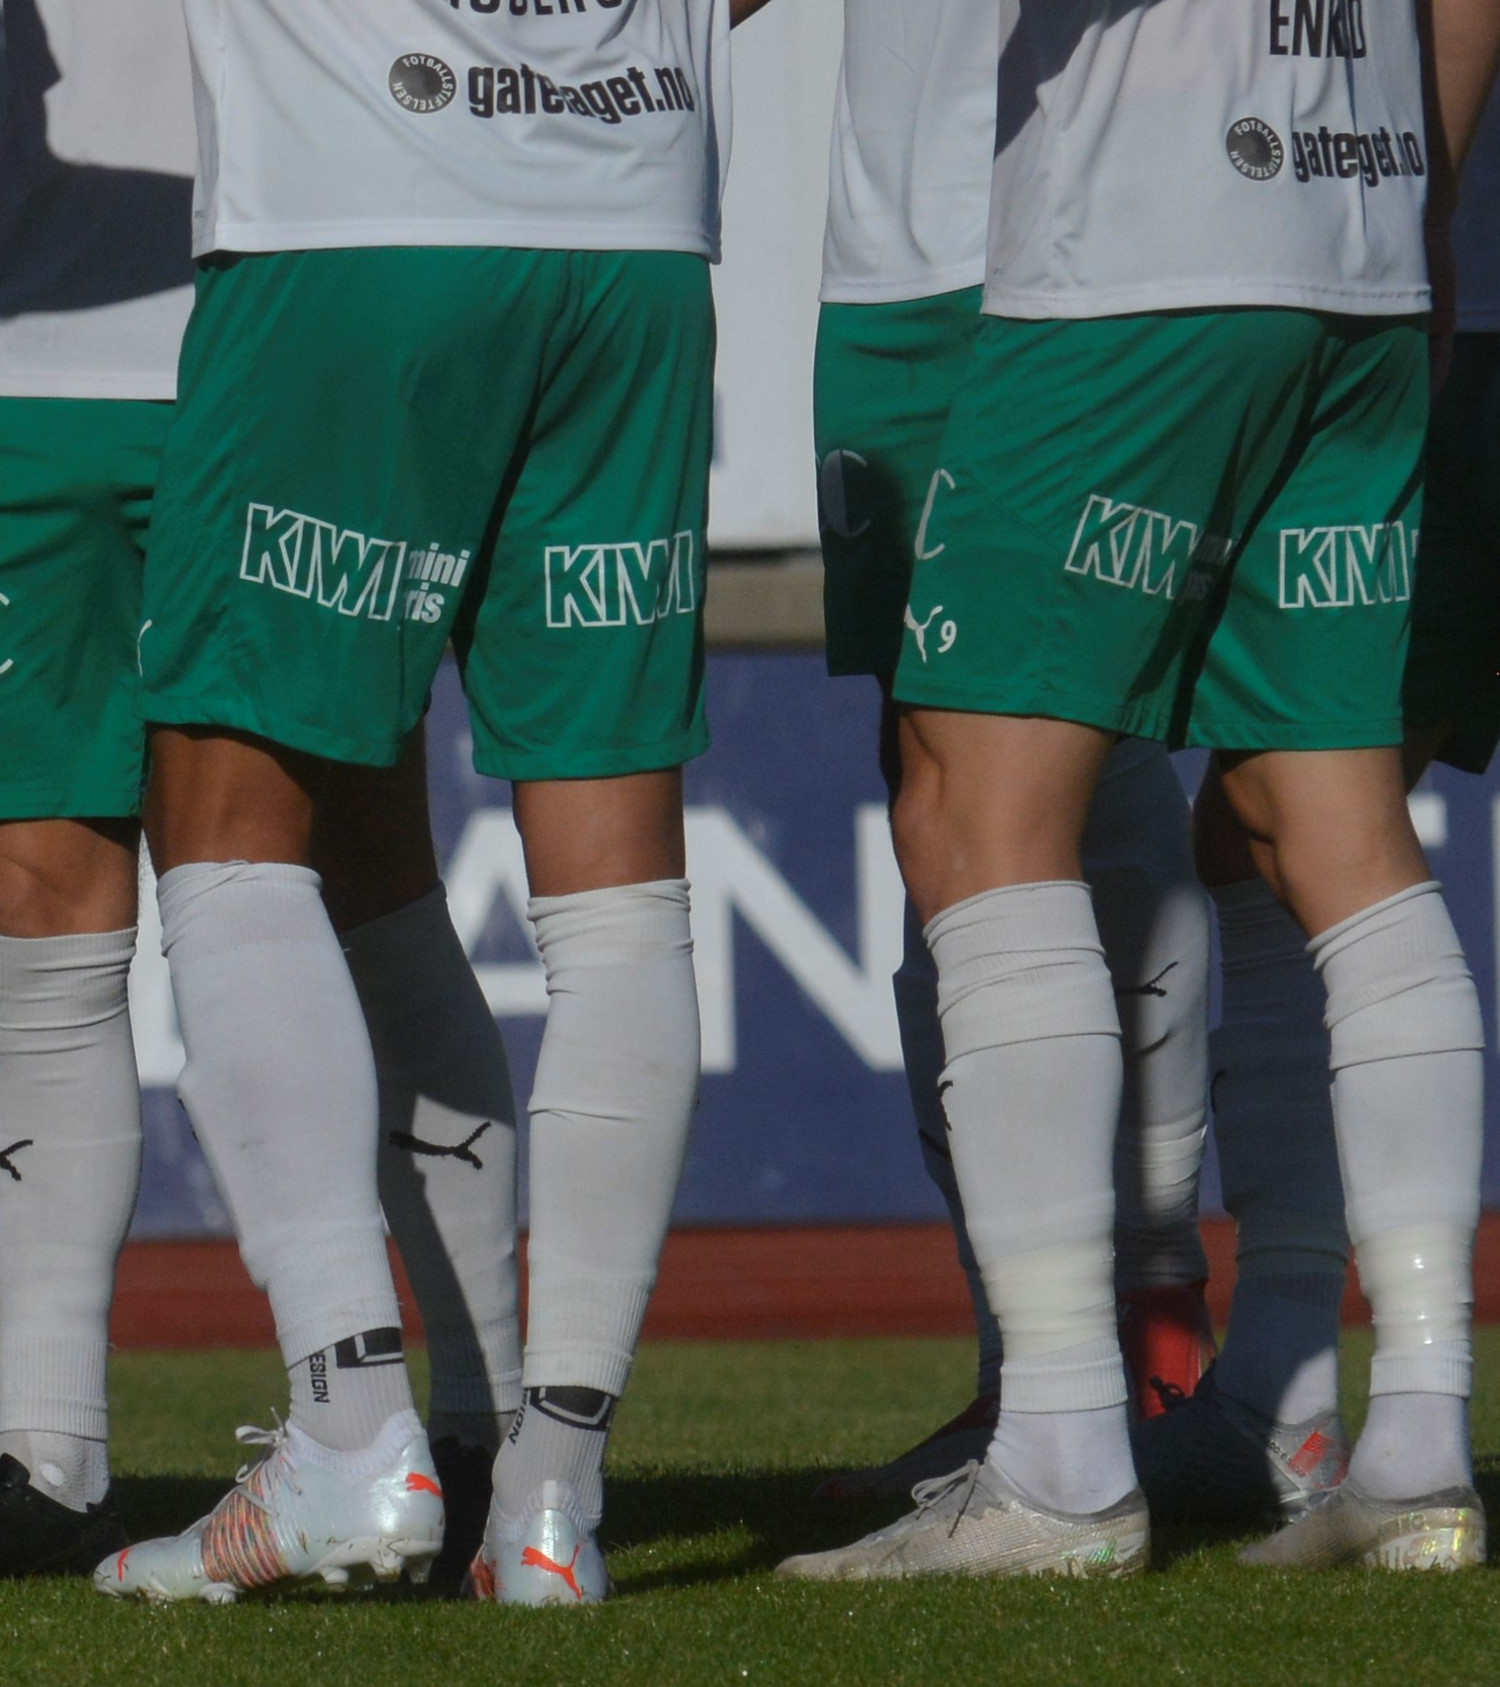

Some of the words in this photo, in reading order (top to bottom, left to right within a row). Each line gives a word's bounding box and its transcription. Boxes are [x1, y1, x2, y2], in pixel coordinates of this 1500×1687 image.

[239, 502, 406, 621] KIWI
[403, 581, 445, 624] ris
[938, 620, 957, 654] 9
[308, 1352, 330, 1404] ESIGN
